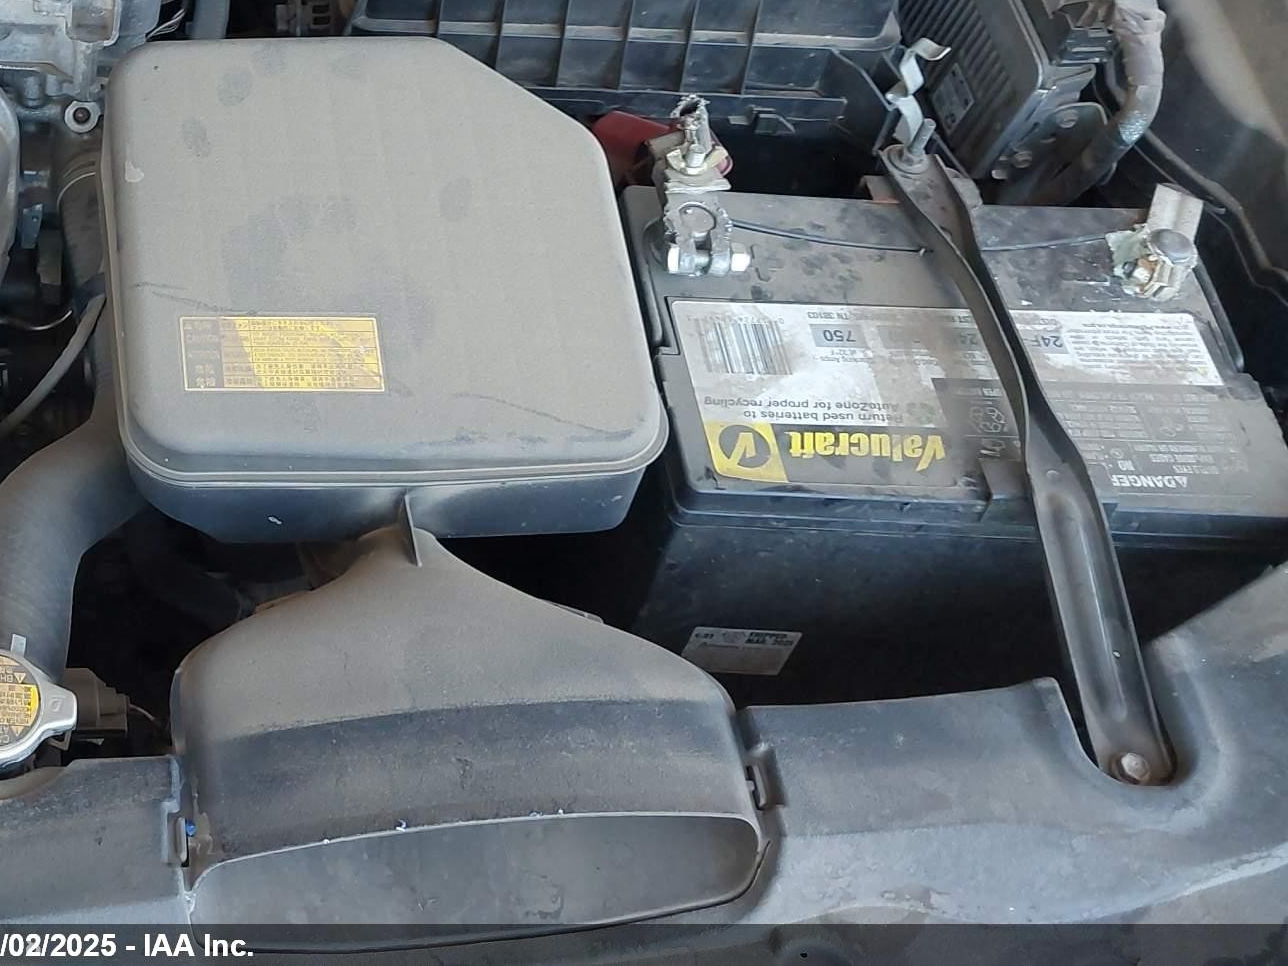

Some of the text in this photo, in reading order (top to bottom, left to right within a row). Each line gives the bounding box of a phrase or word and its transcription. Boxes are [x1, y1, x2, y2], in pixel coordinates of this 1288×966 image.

[823, 329, 857, 343] 750
[704, 396, 899, 412] AutoZone for proper recycling
[743, 410, 757, 419] to
[761, 410, 819, 422] batteries
[823, 410, 854, 422] used
[784, 430, 946, 472] Valucraft
